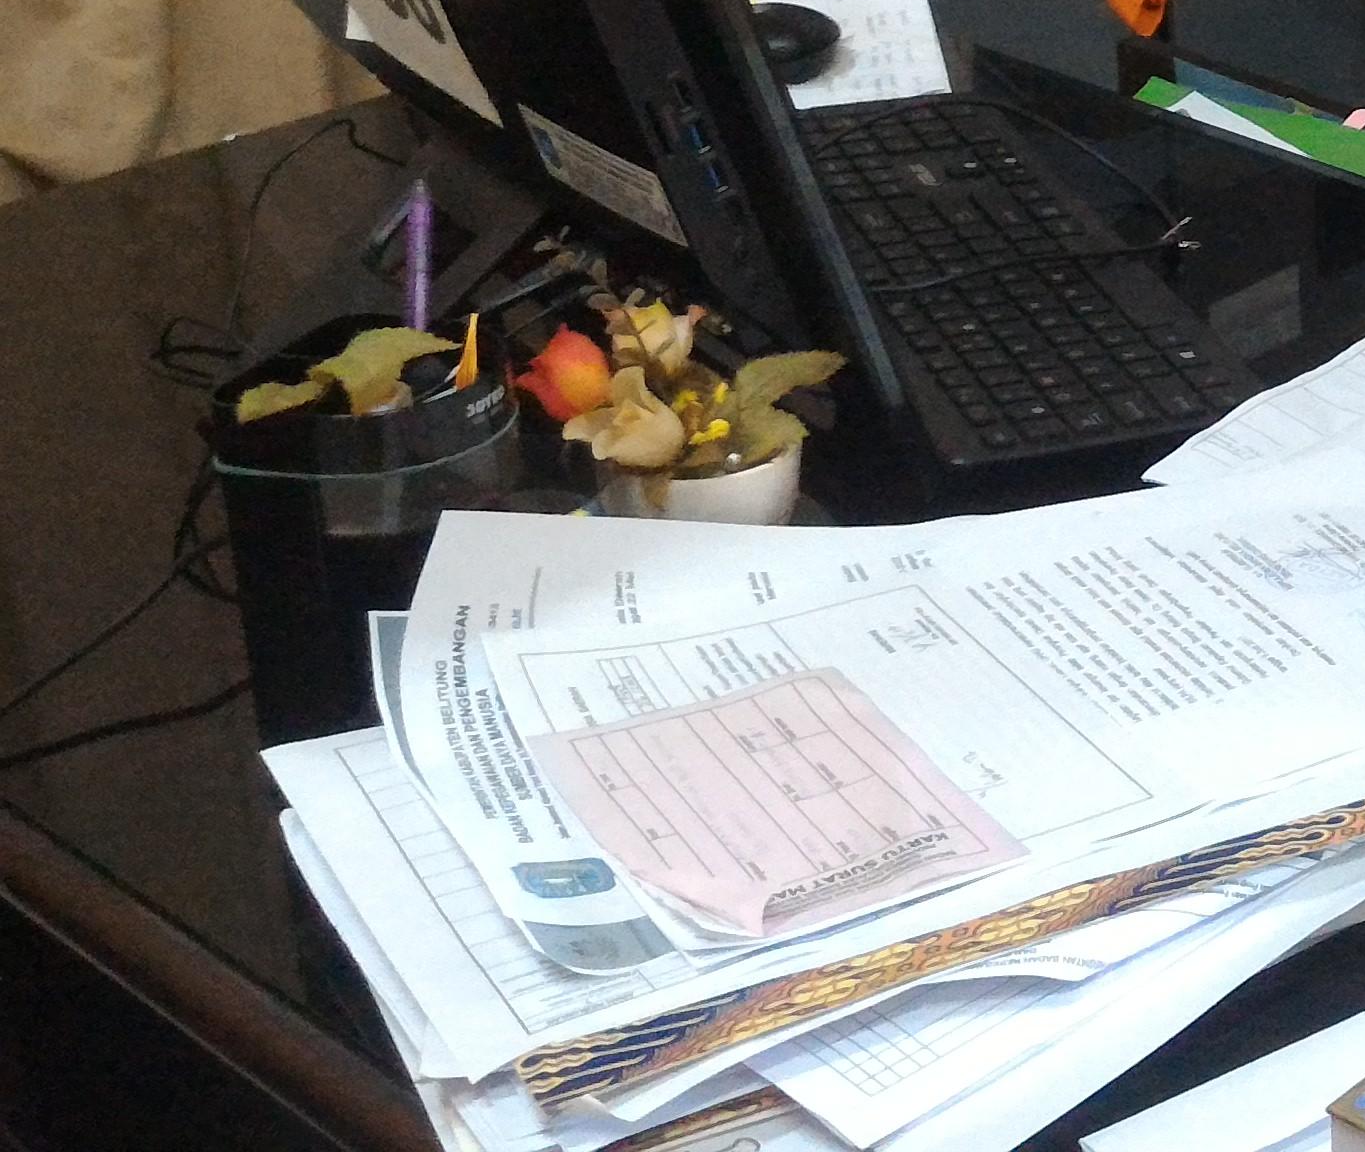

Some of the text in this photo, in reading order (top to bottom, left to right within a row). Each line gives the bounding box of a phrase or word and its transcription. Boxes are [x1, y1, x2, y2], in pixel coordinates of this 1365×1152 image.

[452, 605, 476, 734] PENGEMBANGAN
[435, 661, 454, 725] BELITUNG
[475, 688, 502, 740] MANUSIA
[467, 732, 486, 754] DAN
[880, 832, 949, 861] KARTU
[813, 857, 878, 888] SURAT
